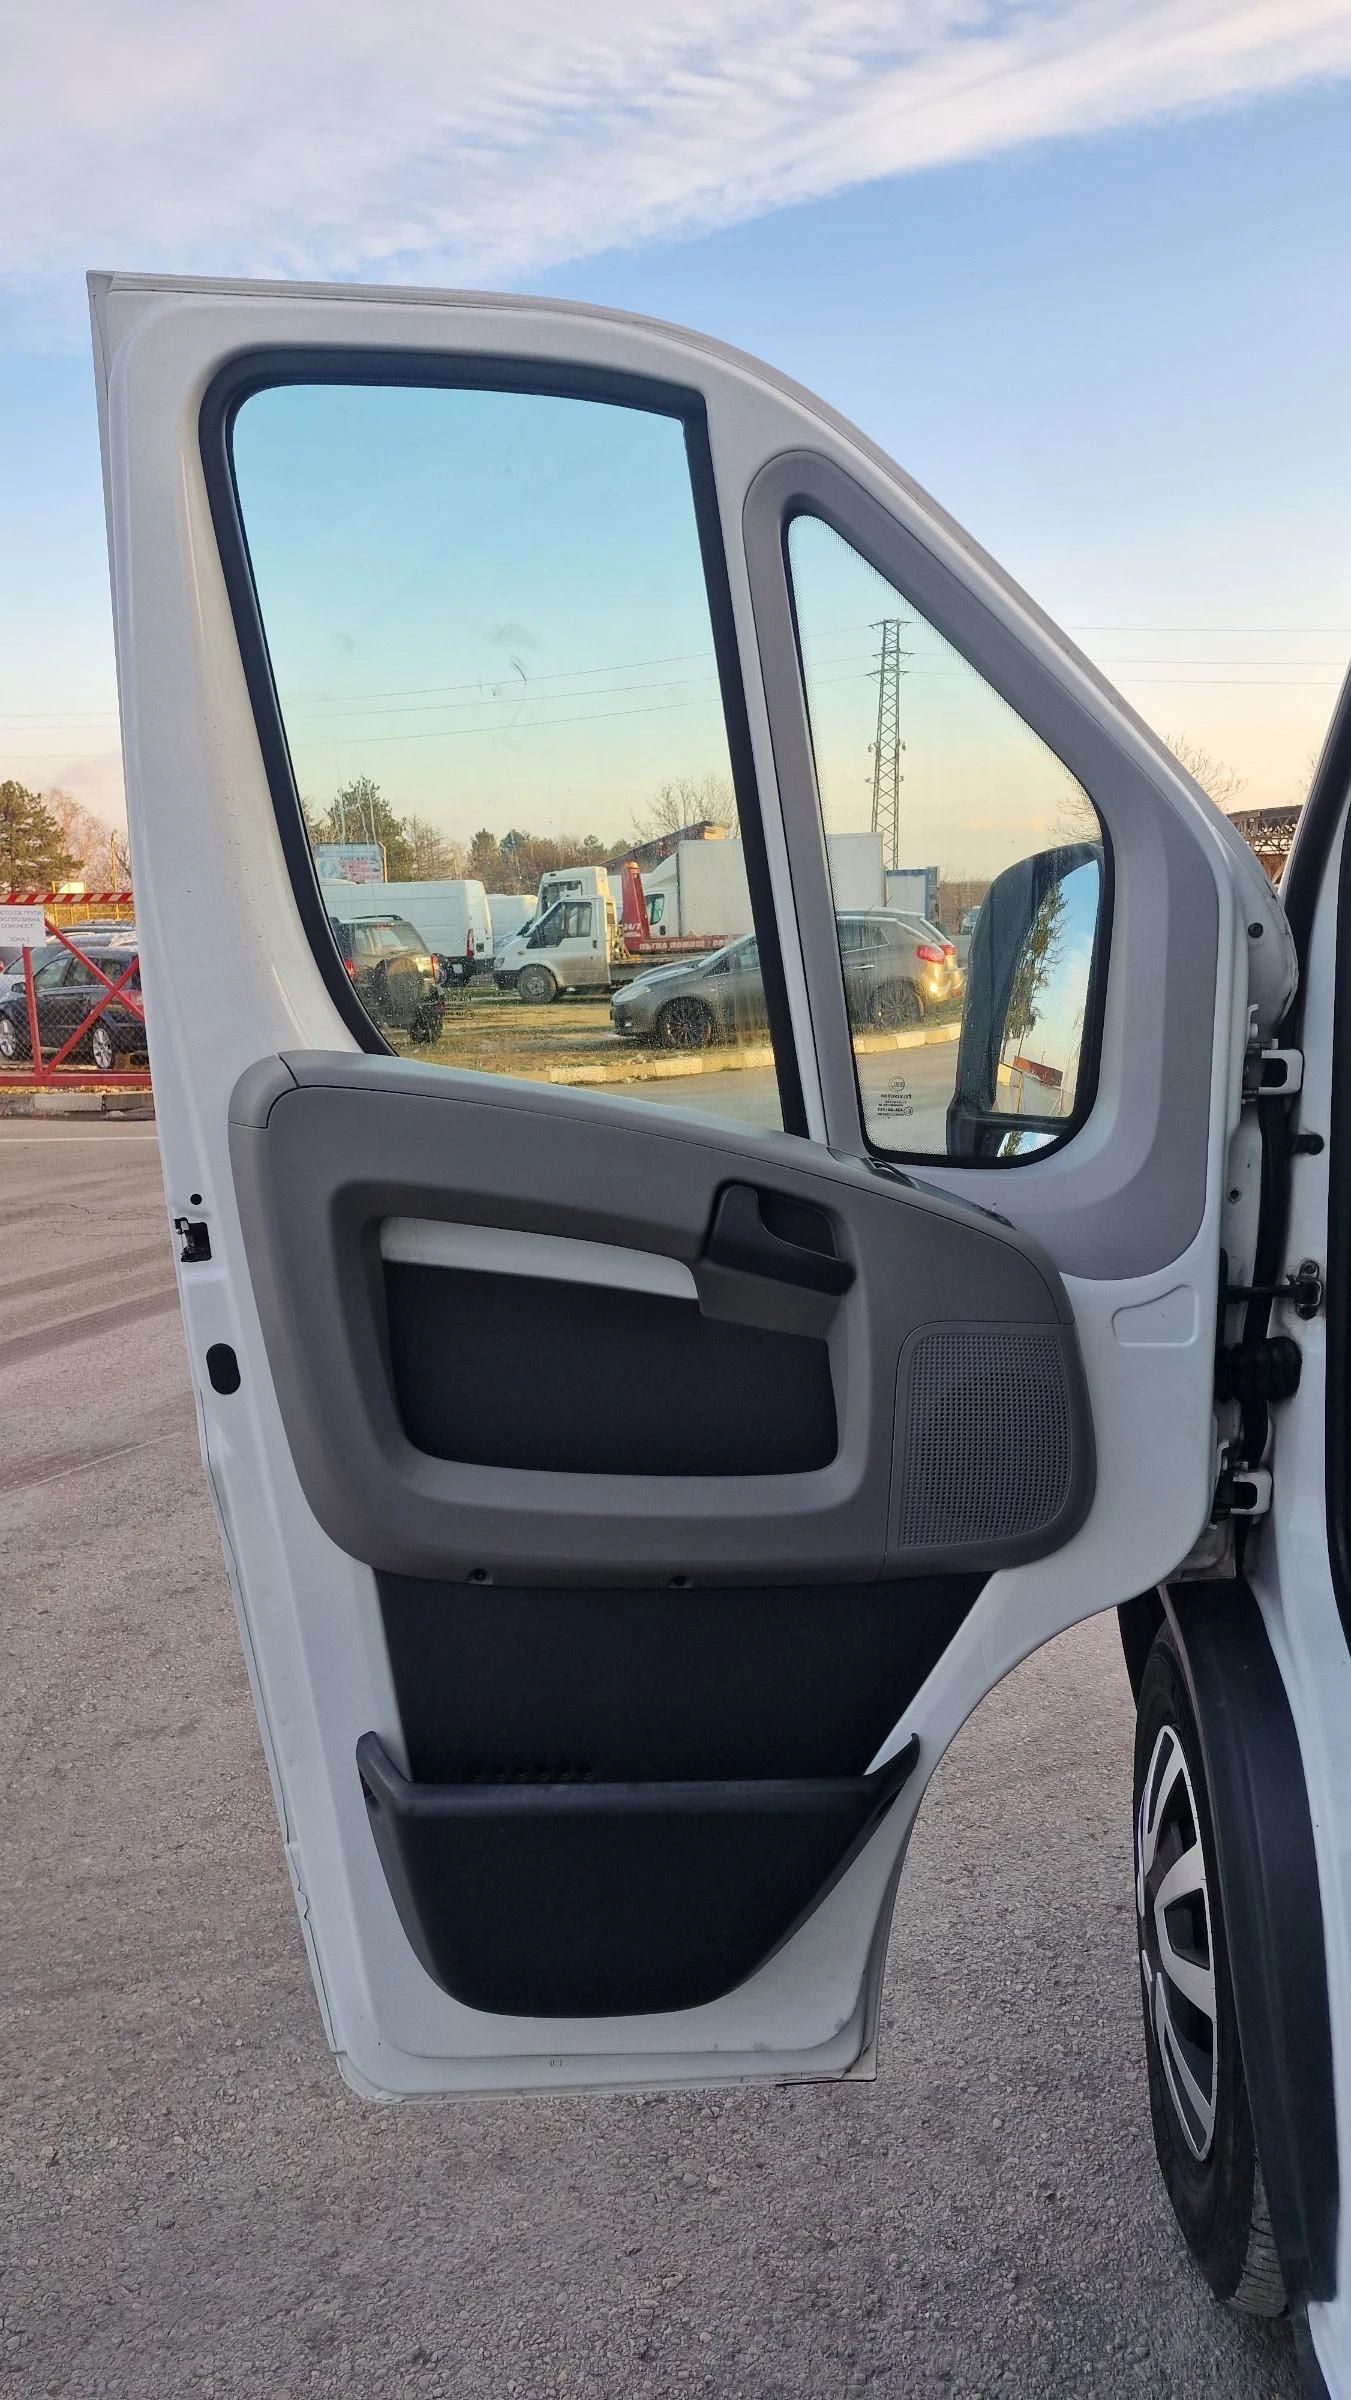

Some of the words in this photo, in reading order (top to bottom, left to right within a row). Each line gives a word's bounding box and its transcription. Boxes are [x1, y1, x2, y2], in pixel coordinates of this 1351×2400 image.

[623, 923, 641, 931] 24/7
[639, 942, 668, 951] ПЪТНА
[669, 940, 705, 949] ПОМОЩ
